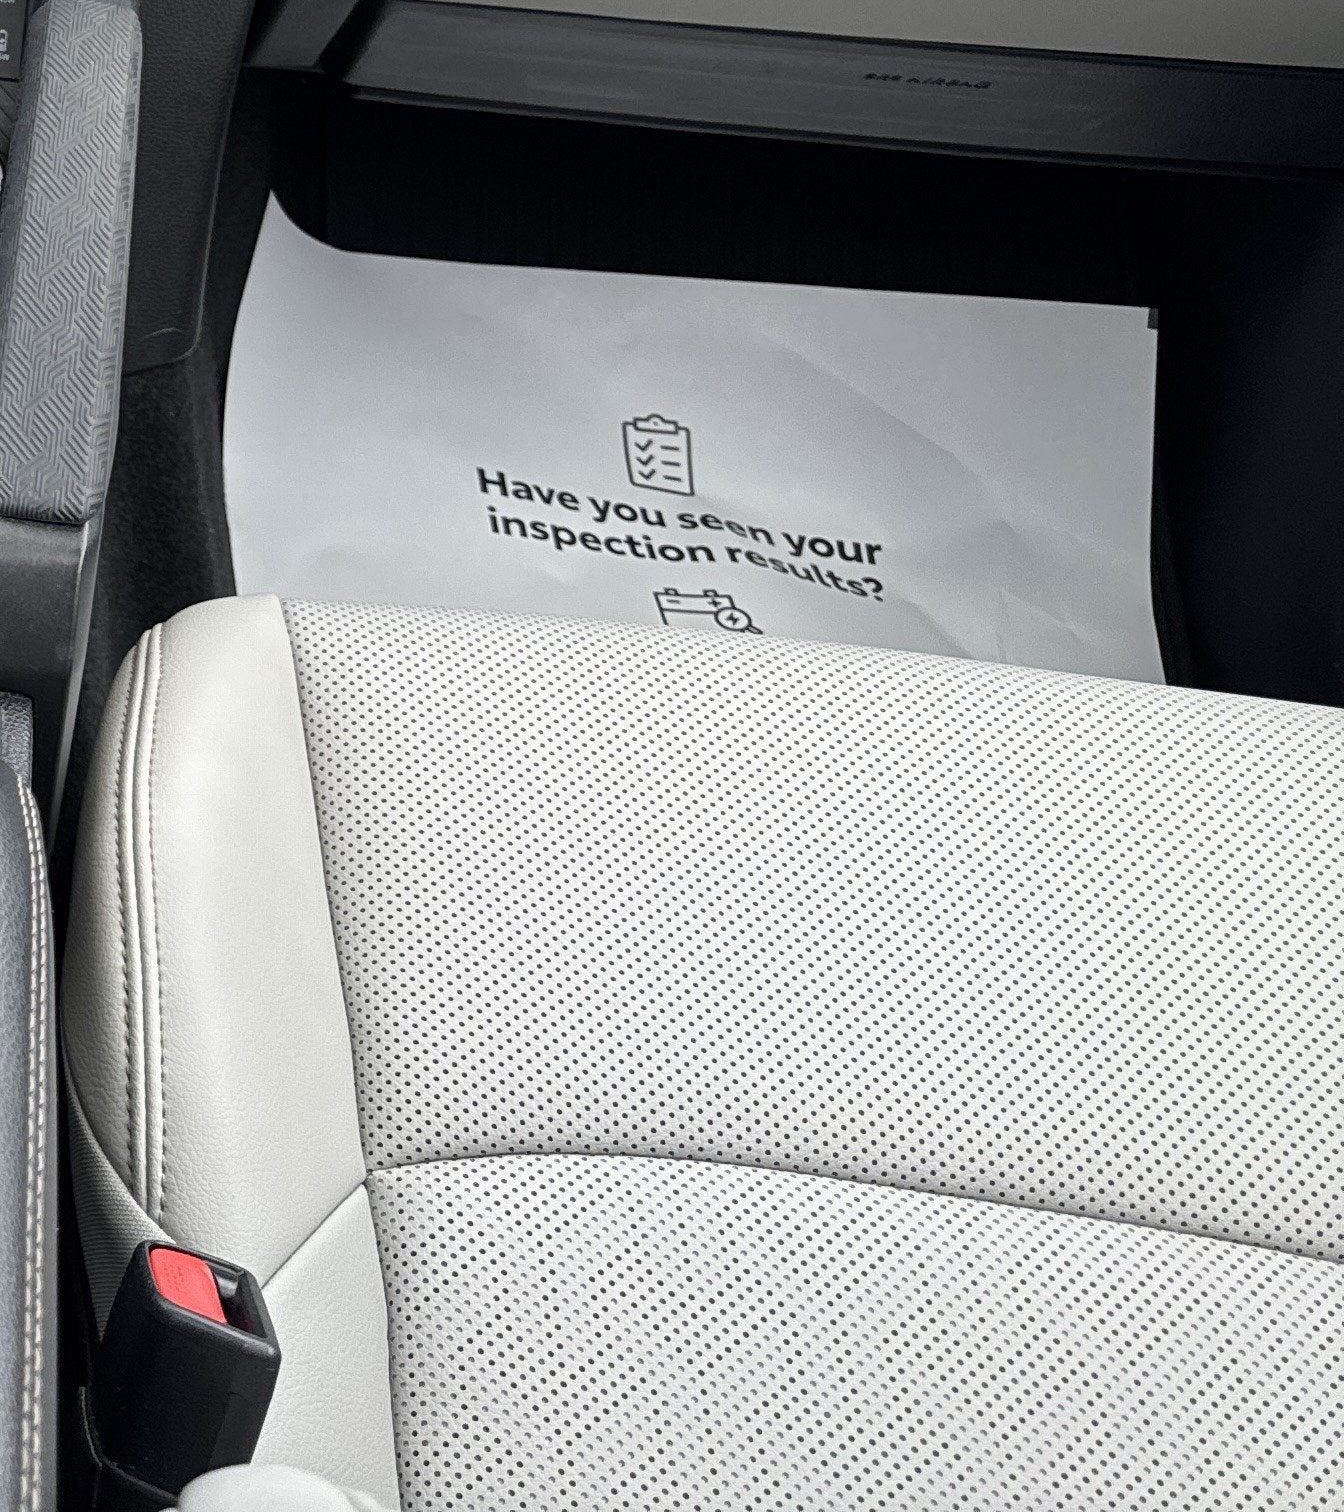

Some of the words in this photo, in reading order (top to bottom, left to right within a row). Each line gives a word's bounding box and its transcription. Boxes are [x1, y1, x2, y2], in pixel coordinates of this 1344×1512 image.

[475, 466, 580, 513] Have
[586, 494, 667, 529] you
[676, 510, 776, 547] seen
[780, 529, 883, 566] your
[487, 505, 716, 564] inspection
[724, 544, 885, 603] results?
